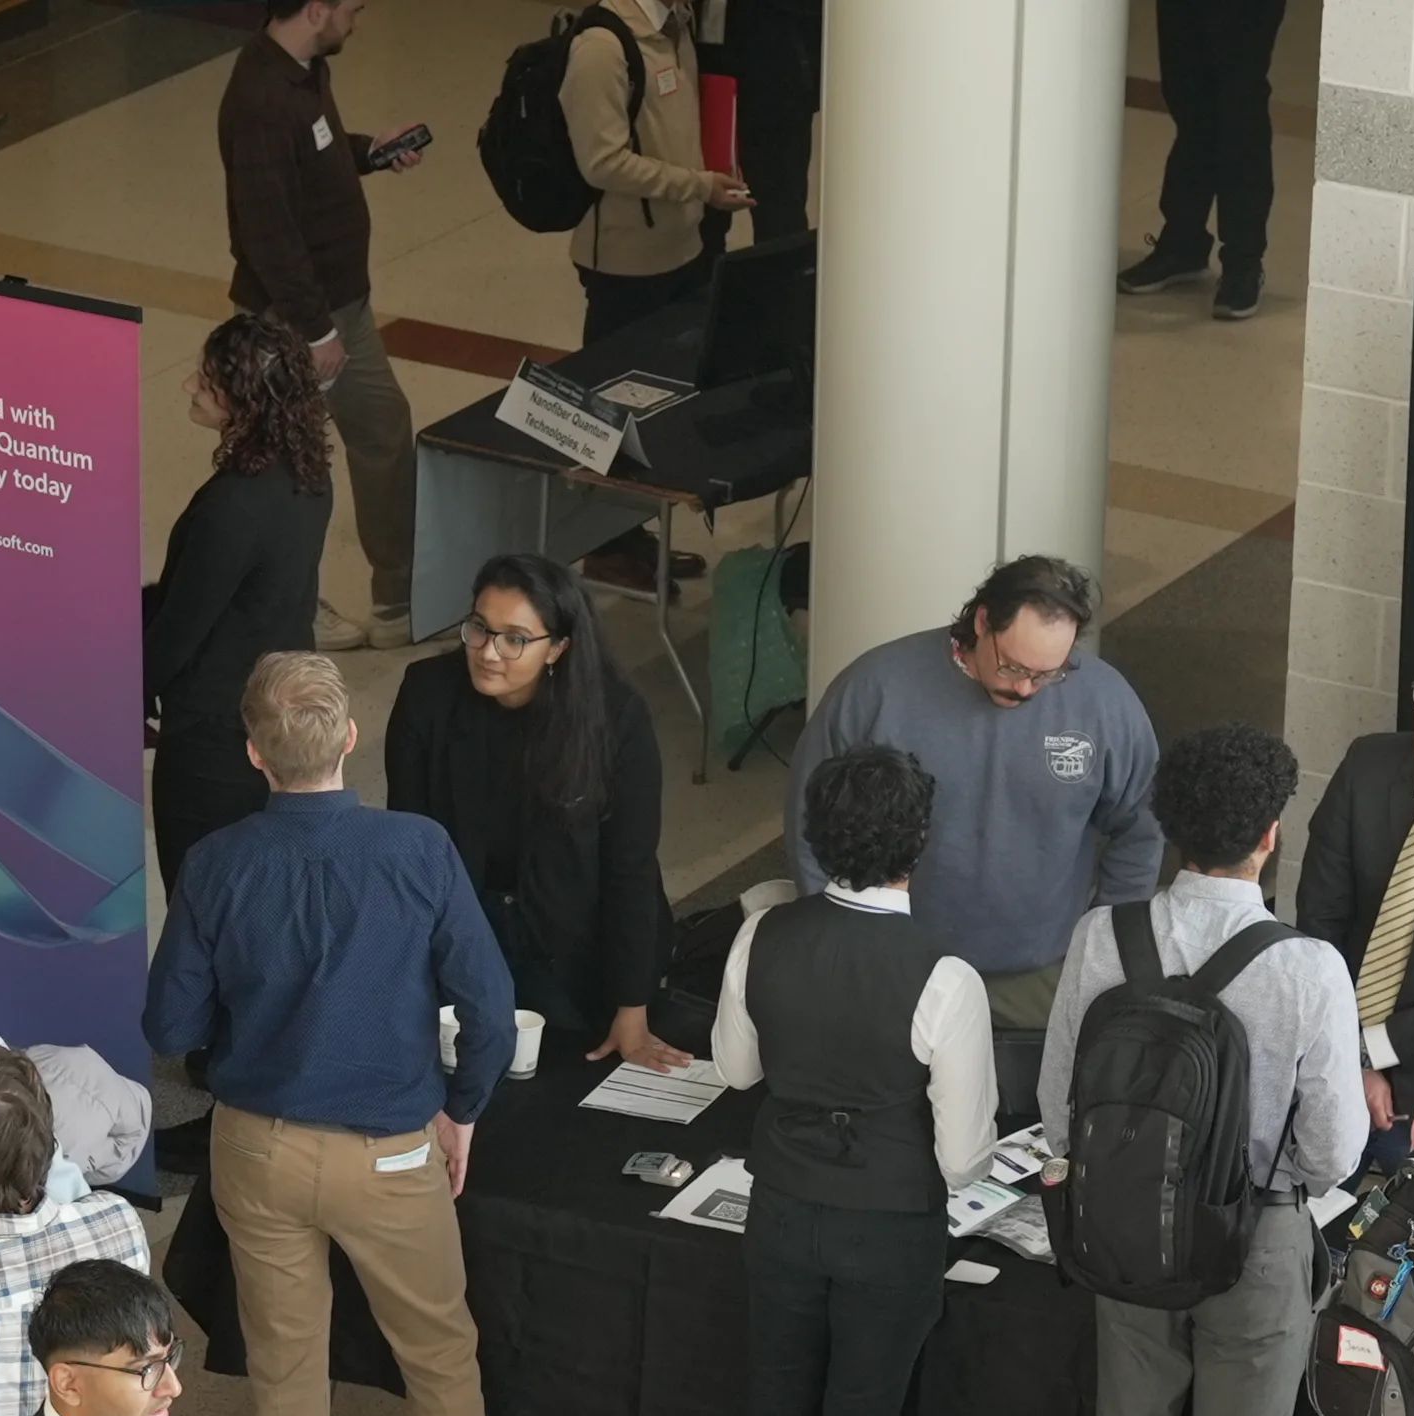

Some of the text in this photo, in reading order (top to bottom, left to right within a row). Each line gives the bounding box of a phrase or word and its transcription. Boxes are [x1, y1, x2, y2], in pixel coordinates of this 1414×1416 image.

[9, 405, 56, 431] with
[524, 411, 597, 462] Technologies, Inc.
[529, 391, 610, 442] Nanofiber Quantum
[13, 469, 73, 504] today
